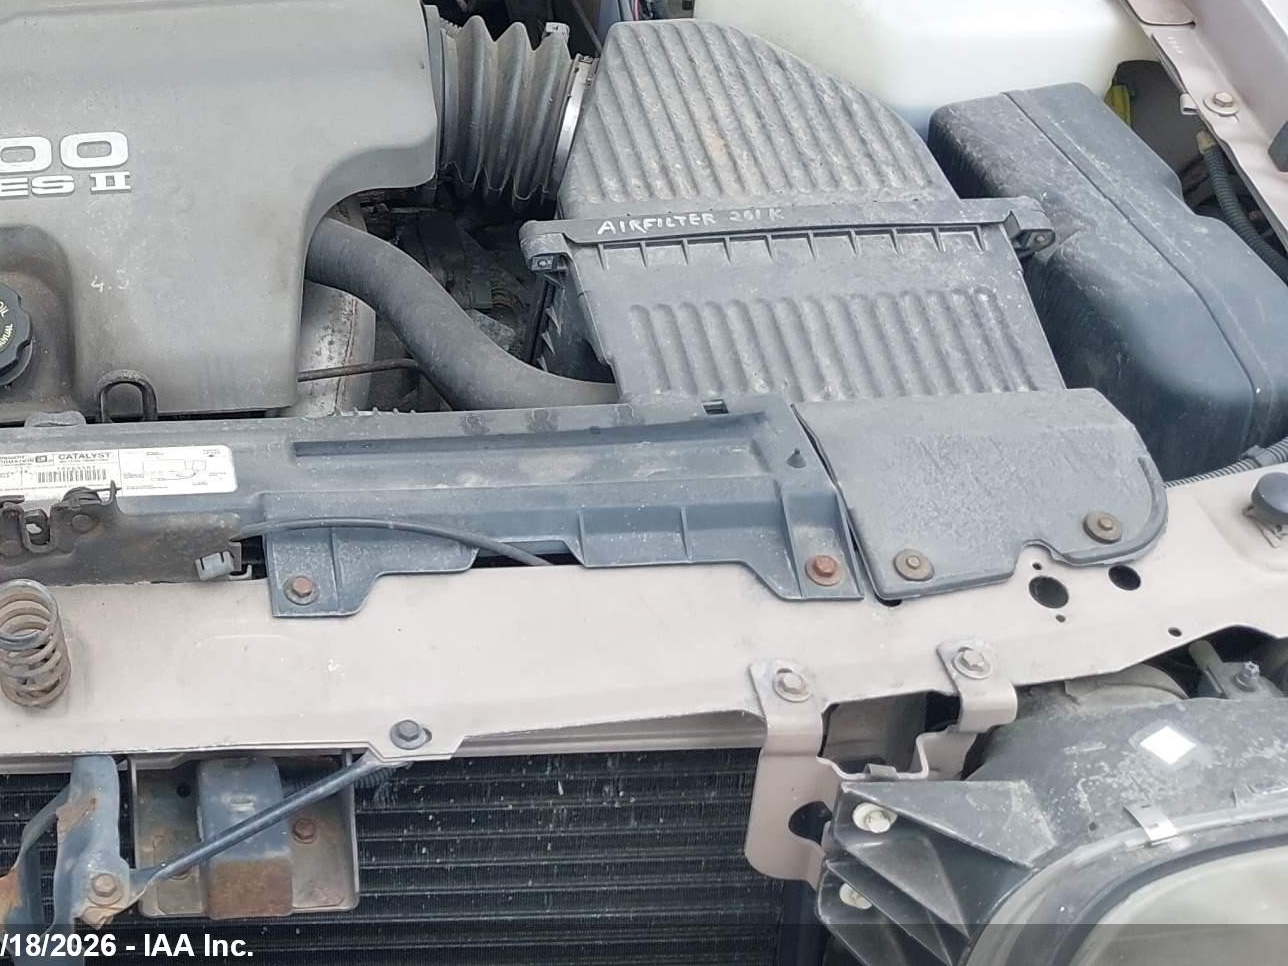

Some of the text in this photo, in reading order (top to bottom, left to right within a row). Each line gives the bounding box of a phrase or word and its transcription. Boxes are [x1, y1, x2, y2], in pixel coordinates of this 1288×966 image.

[89, 171, 132, 193] II
[597, 213, 716, 235] AIRFILTER
[58, 452, 111, 460] CATALYST
